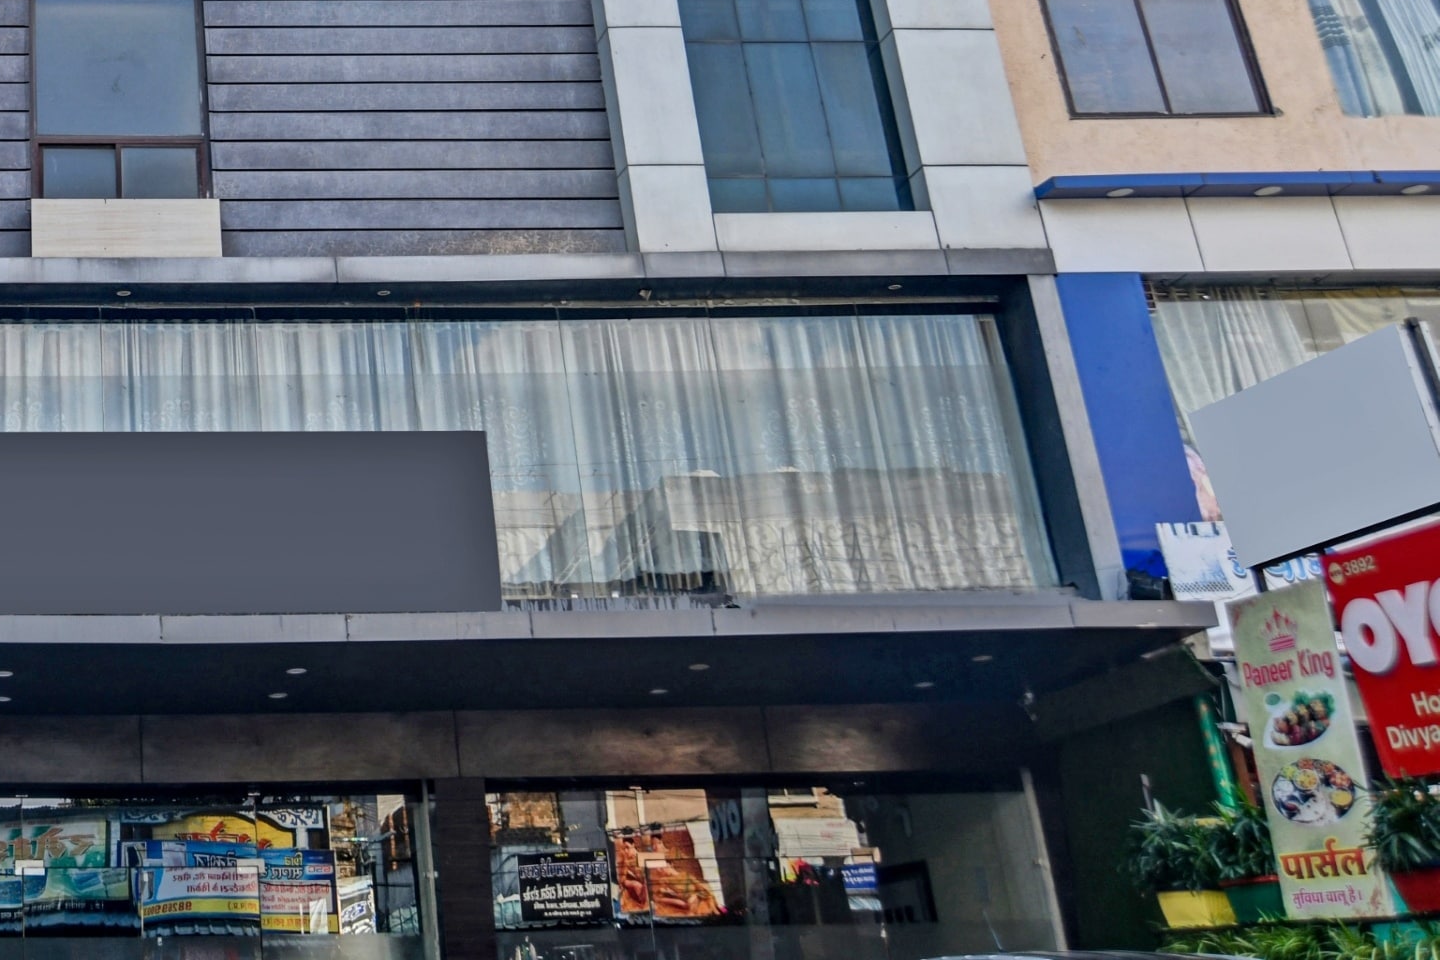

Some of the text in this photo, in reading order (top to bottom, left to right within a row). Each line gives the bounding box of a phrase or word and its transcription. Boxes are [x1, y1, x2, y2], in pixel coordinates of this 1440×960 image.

[1342, 555, 1376, 576] 3892
[1341, 577, 1440, 675] OY
[1242, 649, 1335, 688] Paneer King
[1410, 691, 1440, 717] Ho
[1279, 839, 1368, 880] पार्सल
